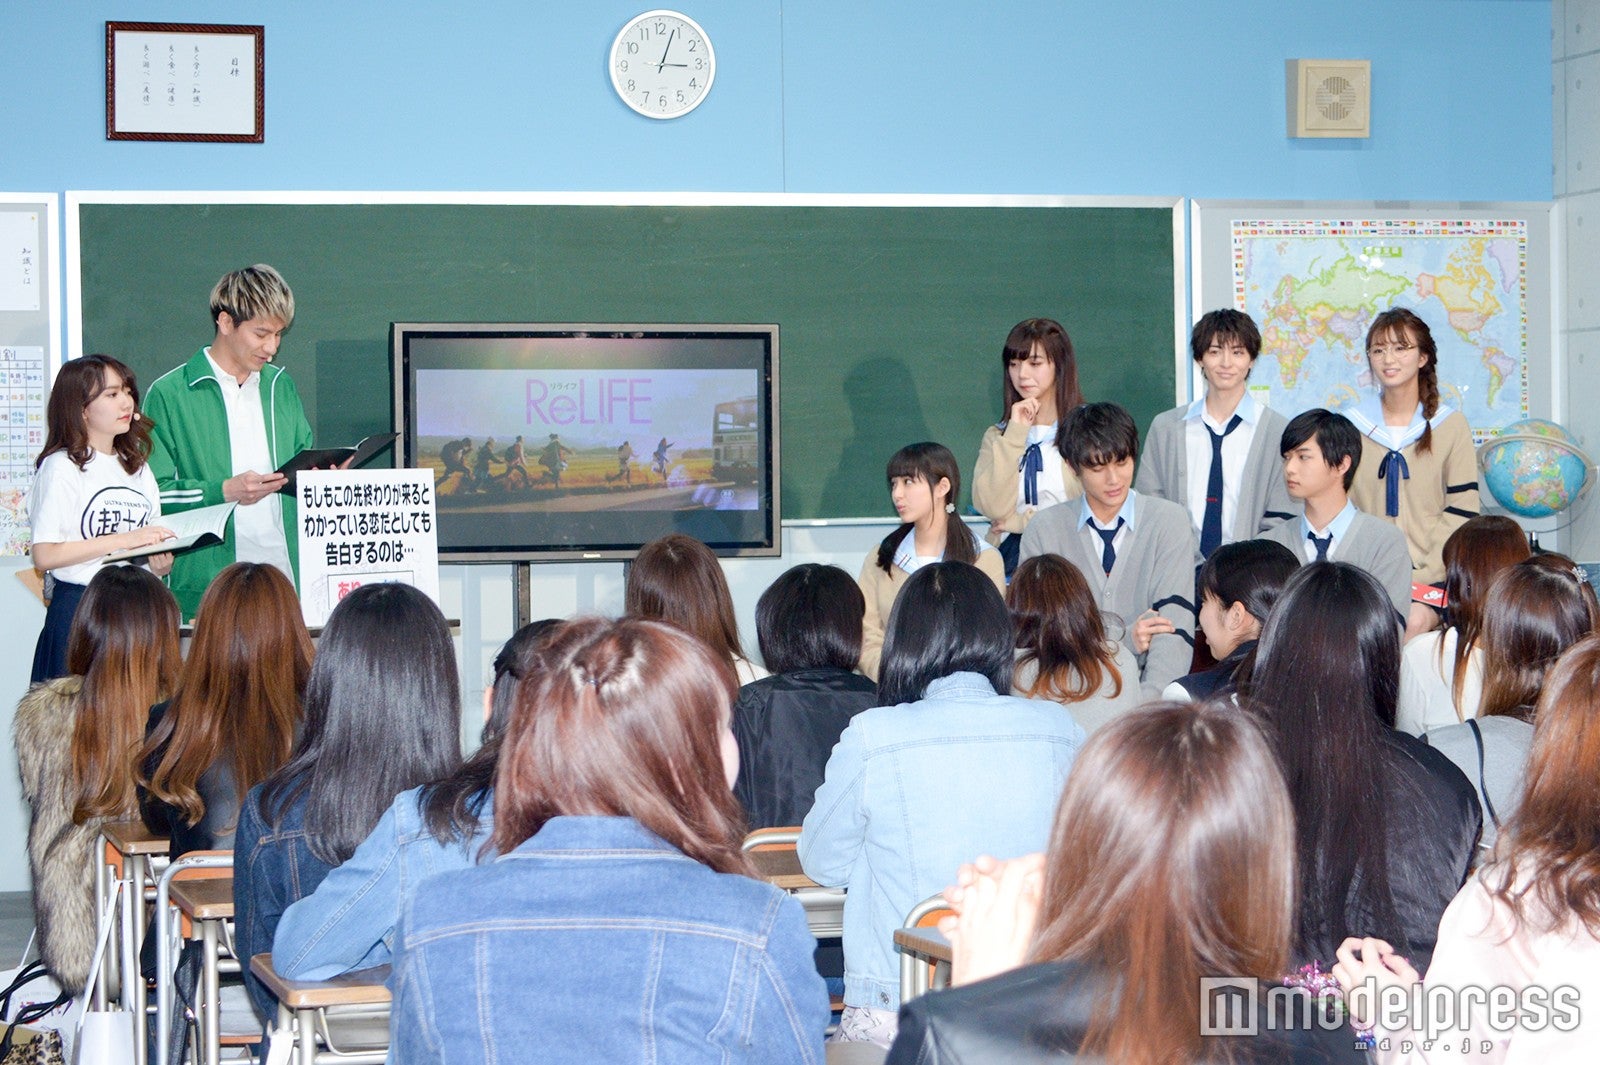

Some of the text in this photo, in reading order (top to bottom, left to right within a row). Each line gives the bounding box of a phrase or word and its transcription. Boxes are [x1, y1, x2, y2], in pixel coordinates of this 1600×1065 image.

[639, 27, 650, 40] 11
[654, 22, 667, 35] 12
[626, 41, 640, 54] 10
[687, 39, 697, 52] 2
[619, 59, 629, 72] 9
[694, 57, 703, 70] 3
[627, 78, 636, 91] 8
[688, 77, 697, 89] 4
[641, 91, 650, 103] 7
[659, 95, 667, 108] 6
[676, 90, 685, 103] 5
[526, 378, 653, 425] ReLIFE
[303, 483, 430, 508] もしもこの先終わりが来ると
[304, 511, 431, 538] わかっている恋だとしても
